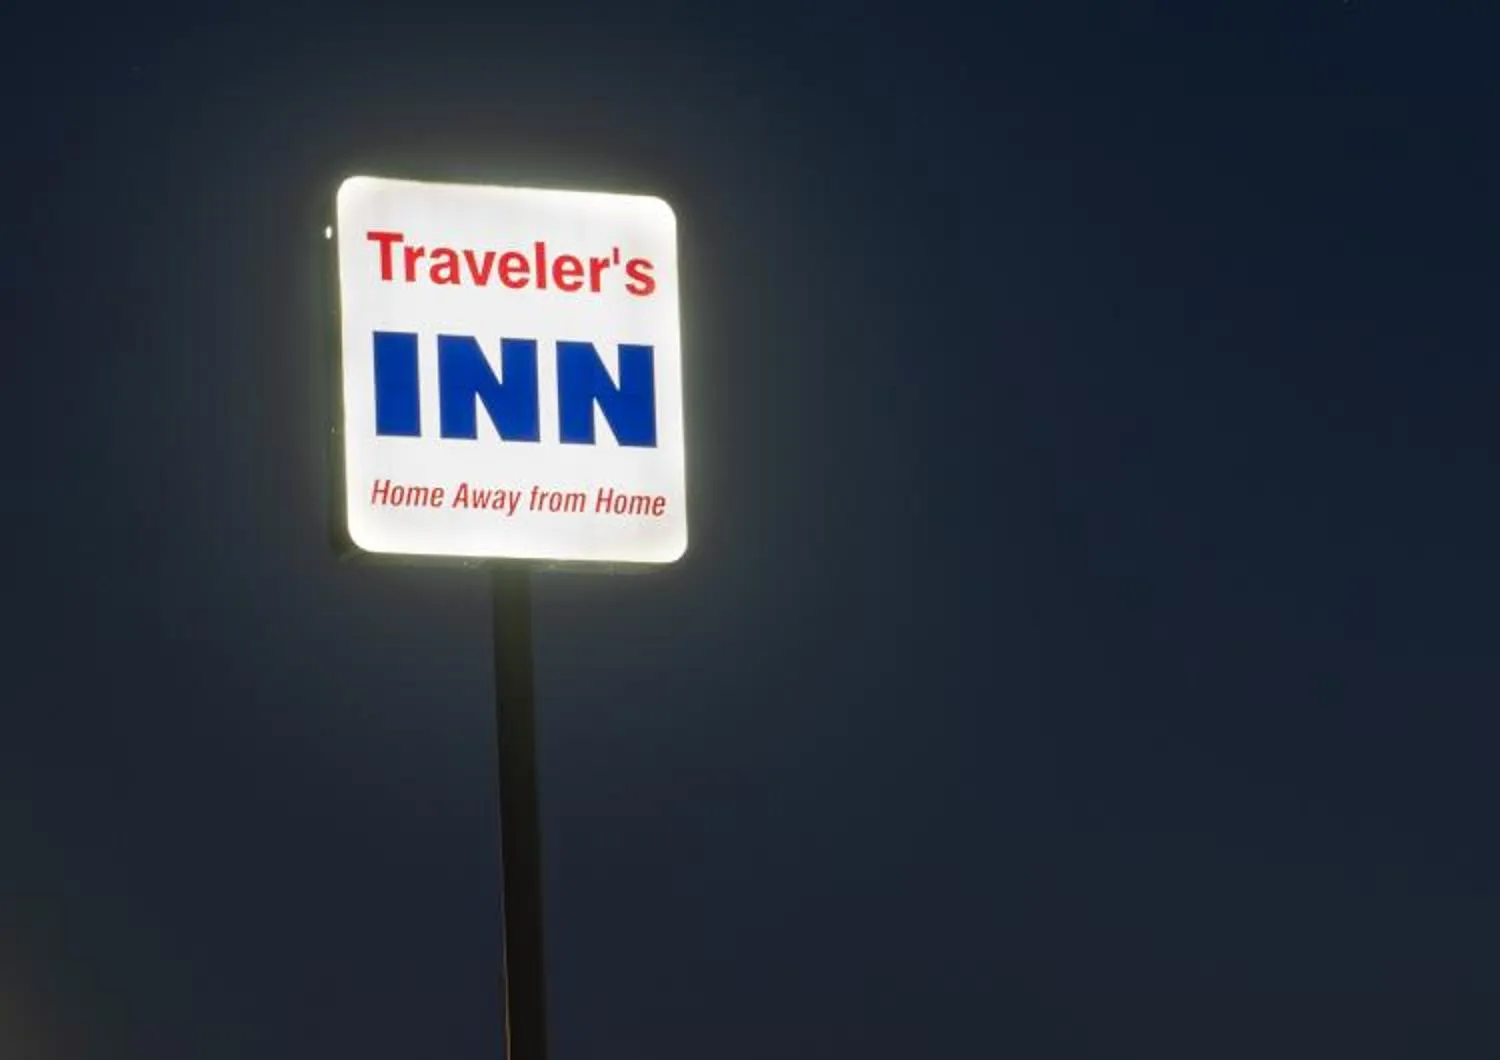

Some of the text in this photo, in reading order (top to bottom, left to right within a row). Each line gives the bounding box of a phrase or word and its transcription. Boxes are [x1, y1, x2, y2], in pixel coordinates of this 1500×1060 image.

[367, 231, 656, 297] Traveler's
[373, 330, 657, 448] INN
[371, 479, 666, 517] Home Away from Home
